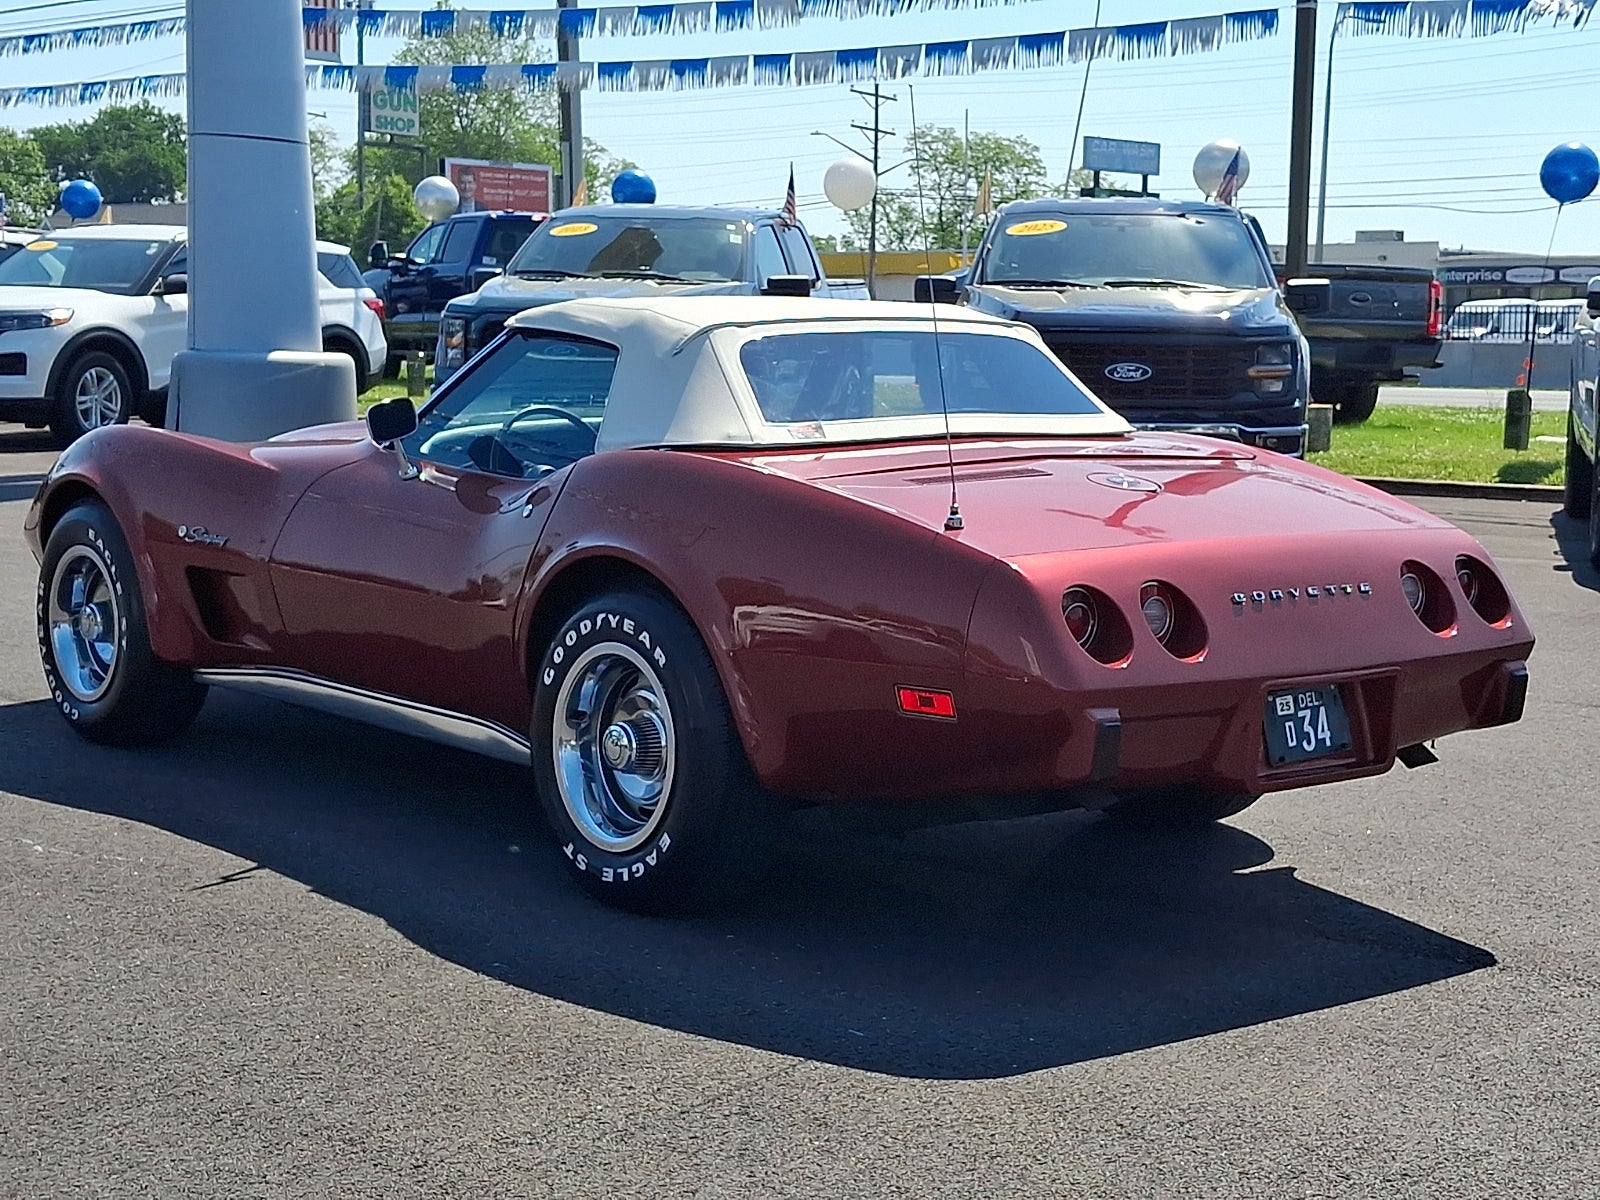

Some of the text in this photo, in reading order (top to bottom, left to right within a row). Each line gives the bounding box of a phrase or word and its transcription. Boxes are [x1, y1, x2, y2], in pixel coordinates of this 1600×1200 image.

[373, 90, 417, 113] GUN
[375, 115, 416, 132] SHOP
[1091, 139, 1117, 153] CAR
[1112, 365, 1145, 379] Ford
[88, 528, 123, 596] EAGLE
[1232, 582, 1372, 605] CORVETTE
[543, 612, 667, 686] GOODYEAR
[1279, 701, 1292, 712] 25
[562, 832, 671, 882] EAGLE ST
